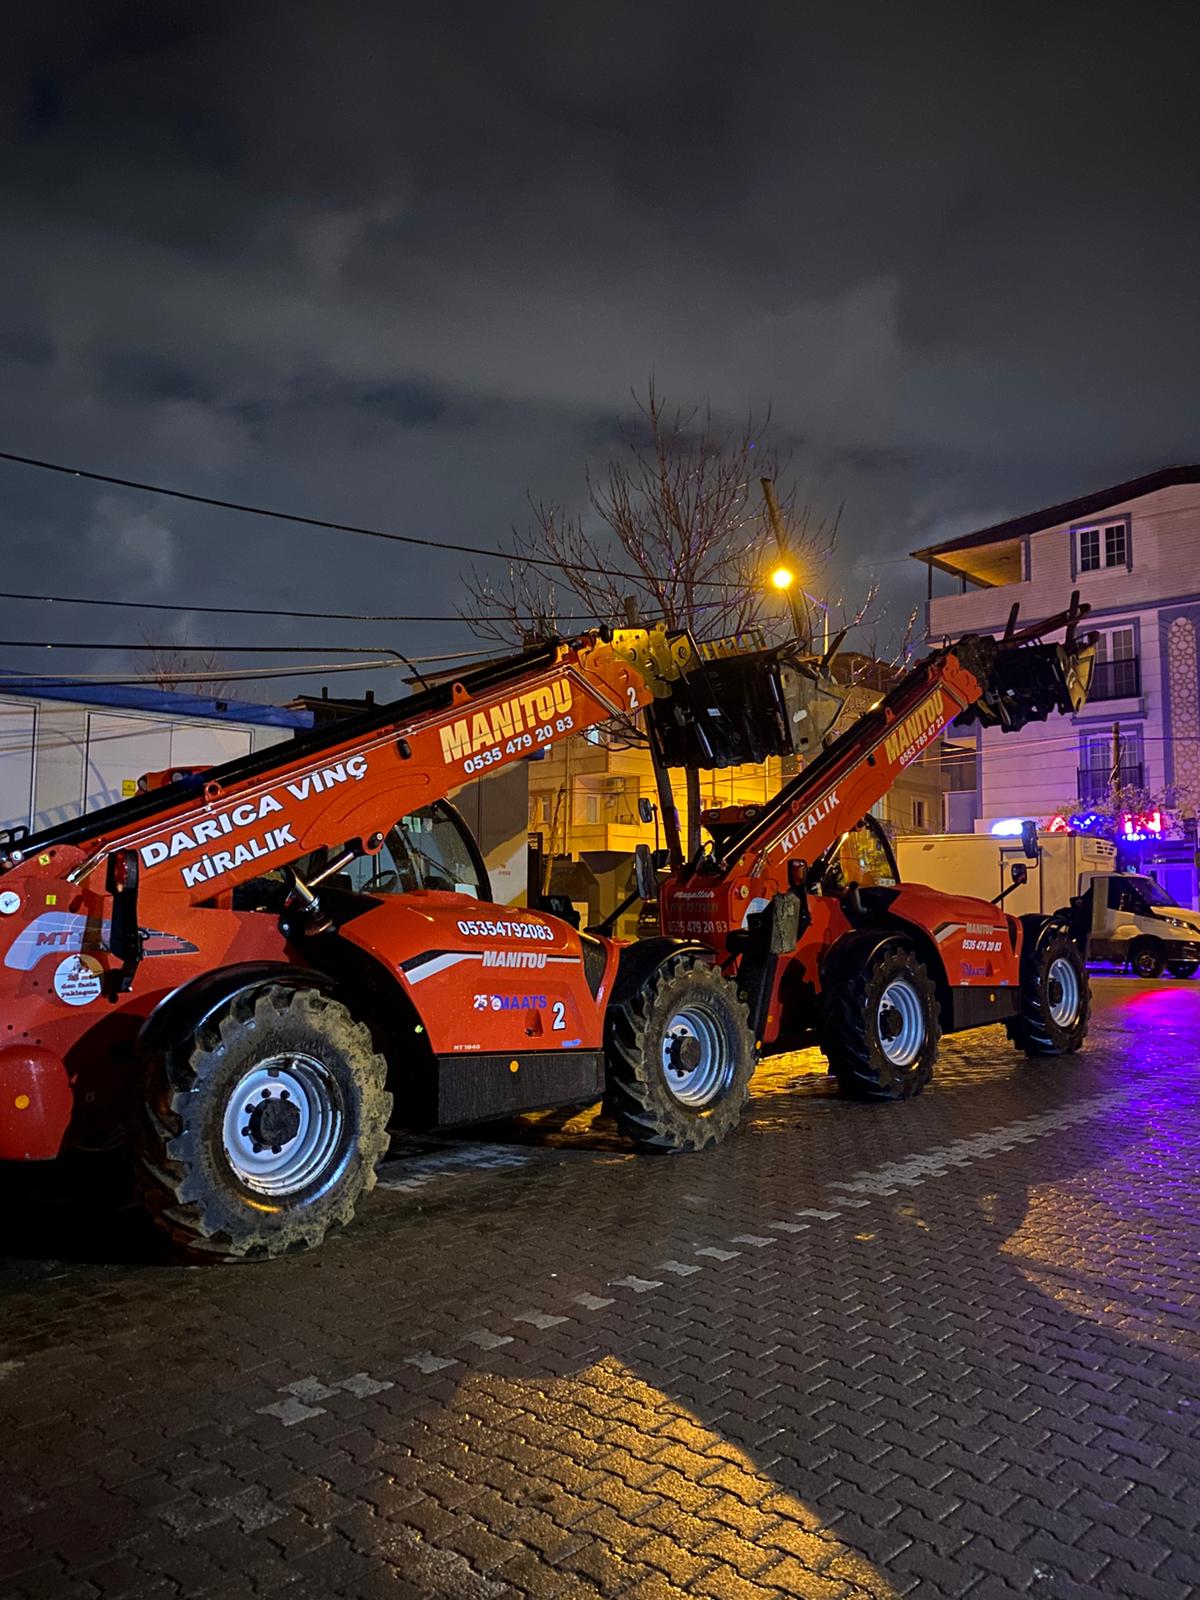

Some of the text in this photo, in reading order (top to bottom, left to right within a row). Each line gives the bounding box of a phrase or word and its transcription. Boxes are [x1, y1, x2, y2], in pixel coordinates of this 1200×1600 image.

[627, 687, 639, 708] 2
[438, 678, 573, 764] MANITOU
[884, 689, 944, 765] MANITOU
[463, 715, 574, 774] 0535 479 20 83
[139, 755, 368, 868] DARICA VİNÇ
[181, 823, 297, 888] KİRALIK
[457, 920, 554, 941] 05354792083
[687, 920, 702, 933] 479
[703, 920, 715, 933] 20
[715, 920, 728, 933] 83
[482, 951, 547, 969] MANITOU
[552, 1001, 566, 1031] 2
